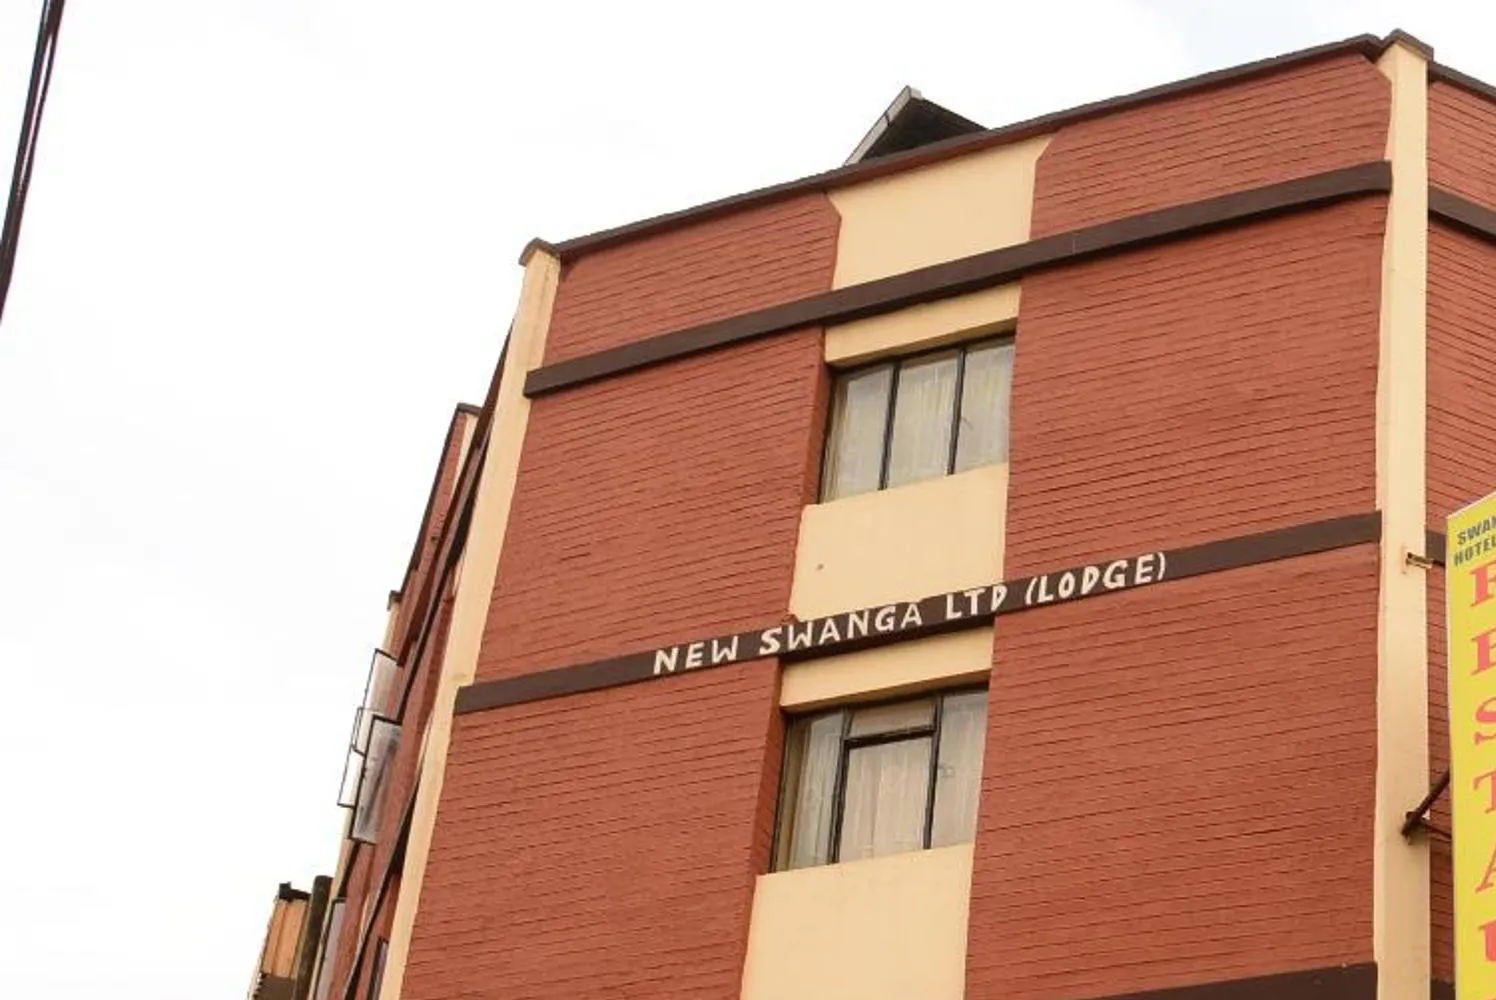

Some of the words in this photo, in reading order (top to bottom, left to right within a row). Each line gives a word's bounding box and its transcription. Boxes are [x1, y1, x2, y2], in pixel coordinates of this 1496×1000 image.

[1453, 537, 1496, 567] HOTEL
[652, 636, 738, 676] NEW
[758, 602, 923, 657] SWANGA
[945, 582, 1008, 620] LTD
[1024, 552, 1166, 606] (LODGE)
